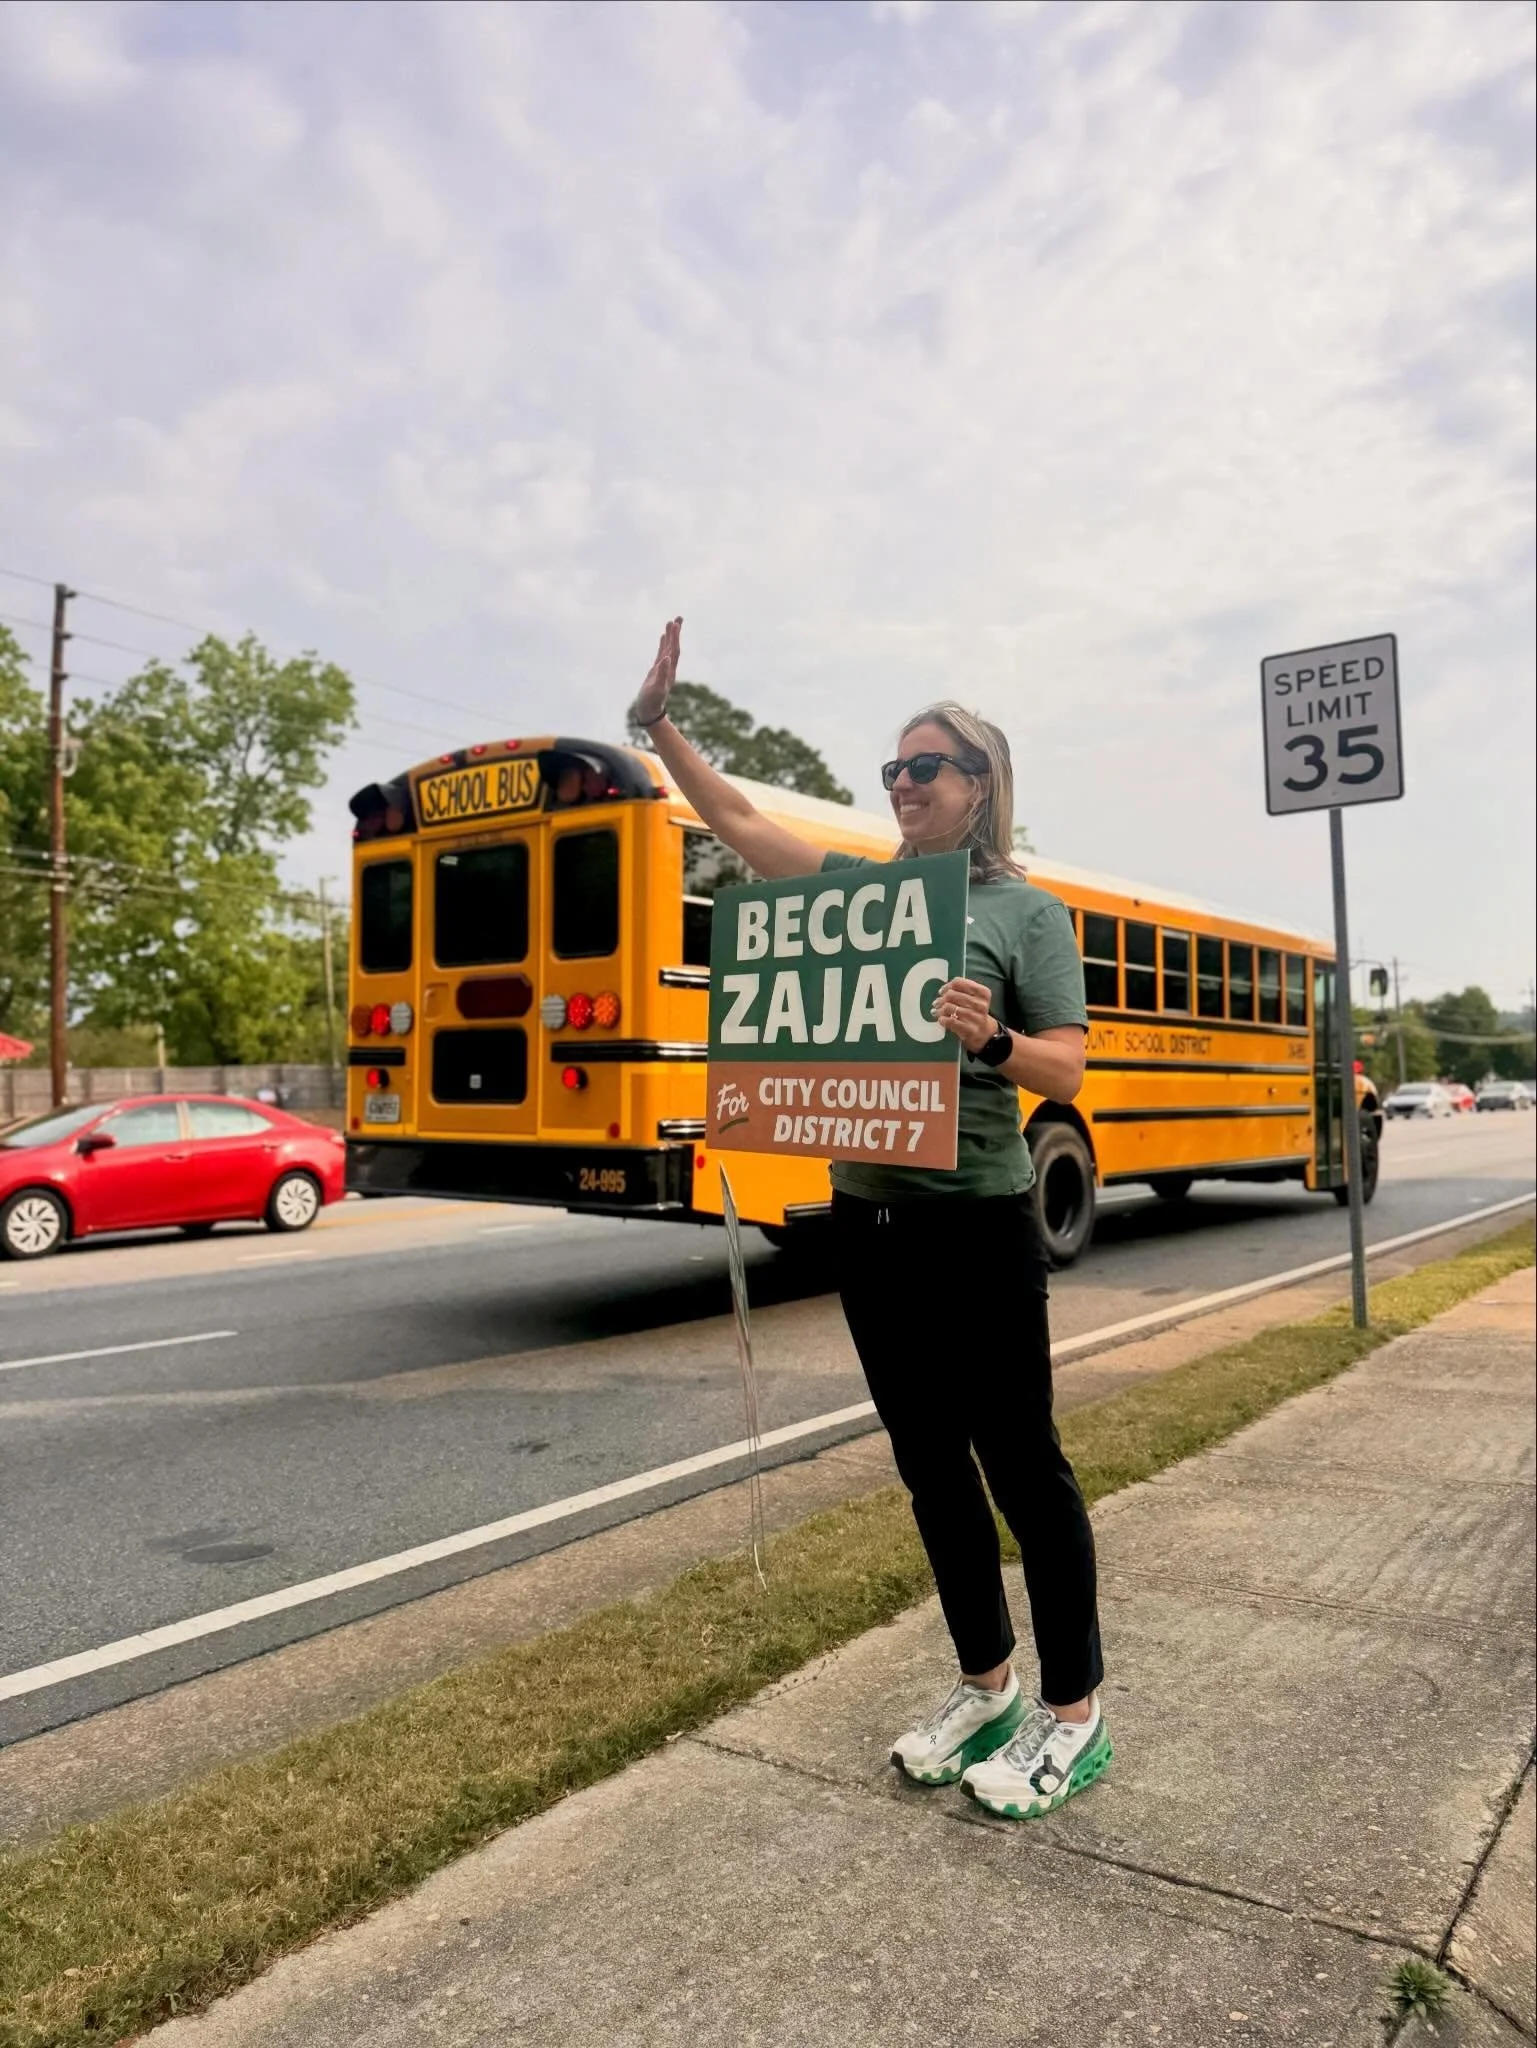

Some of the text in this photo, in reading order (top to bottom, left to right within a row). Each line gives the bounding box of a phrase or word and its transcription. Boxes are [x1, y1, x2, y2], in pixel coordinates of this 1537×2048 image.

[1274, 656, 1385, 696] SPEED
[1287, 691, 1373, 727] LIMIT
[1283, 724, 1385, 793] 35
[427, 762, 533, 818] SCHOOL BUS
[737, 878, 932, 961] BECCA
[720, 958, 949, 1045] ZAJAC
[1125, 1032, 1165, 1053] SCHOOL
[1170, 1034, 1212, 1055] DISTRICT
[717, 1077, 946, 1121] For CITY COUNCIL
[773, 1114, 925, 1152] DISTRICT 7
